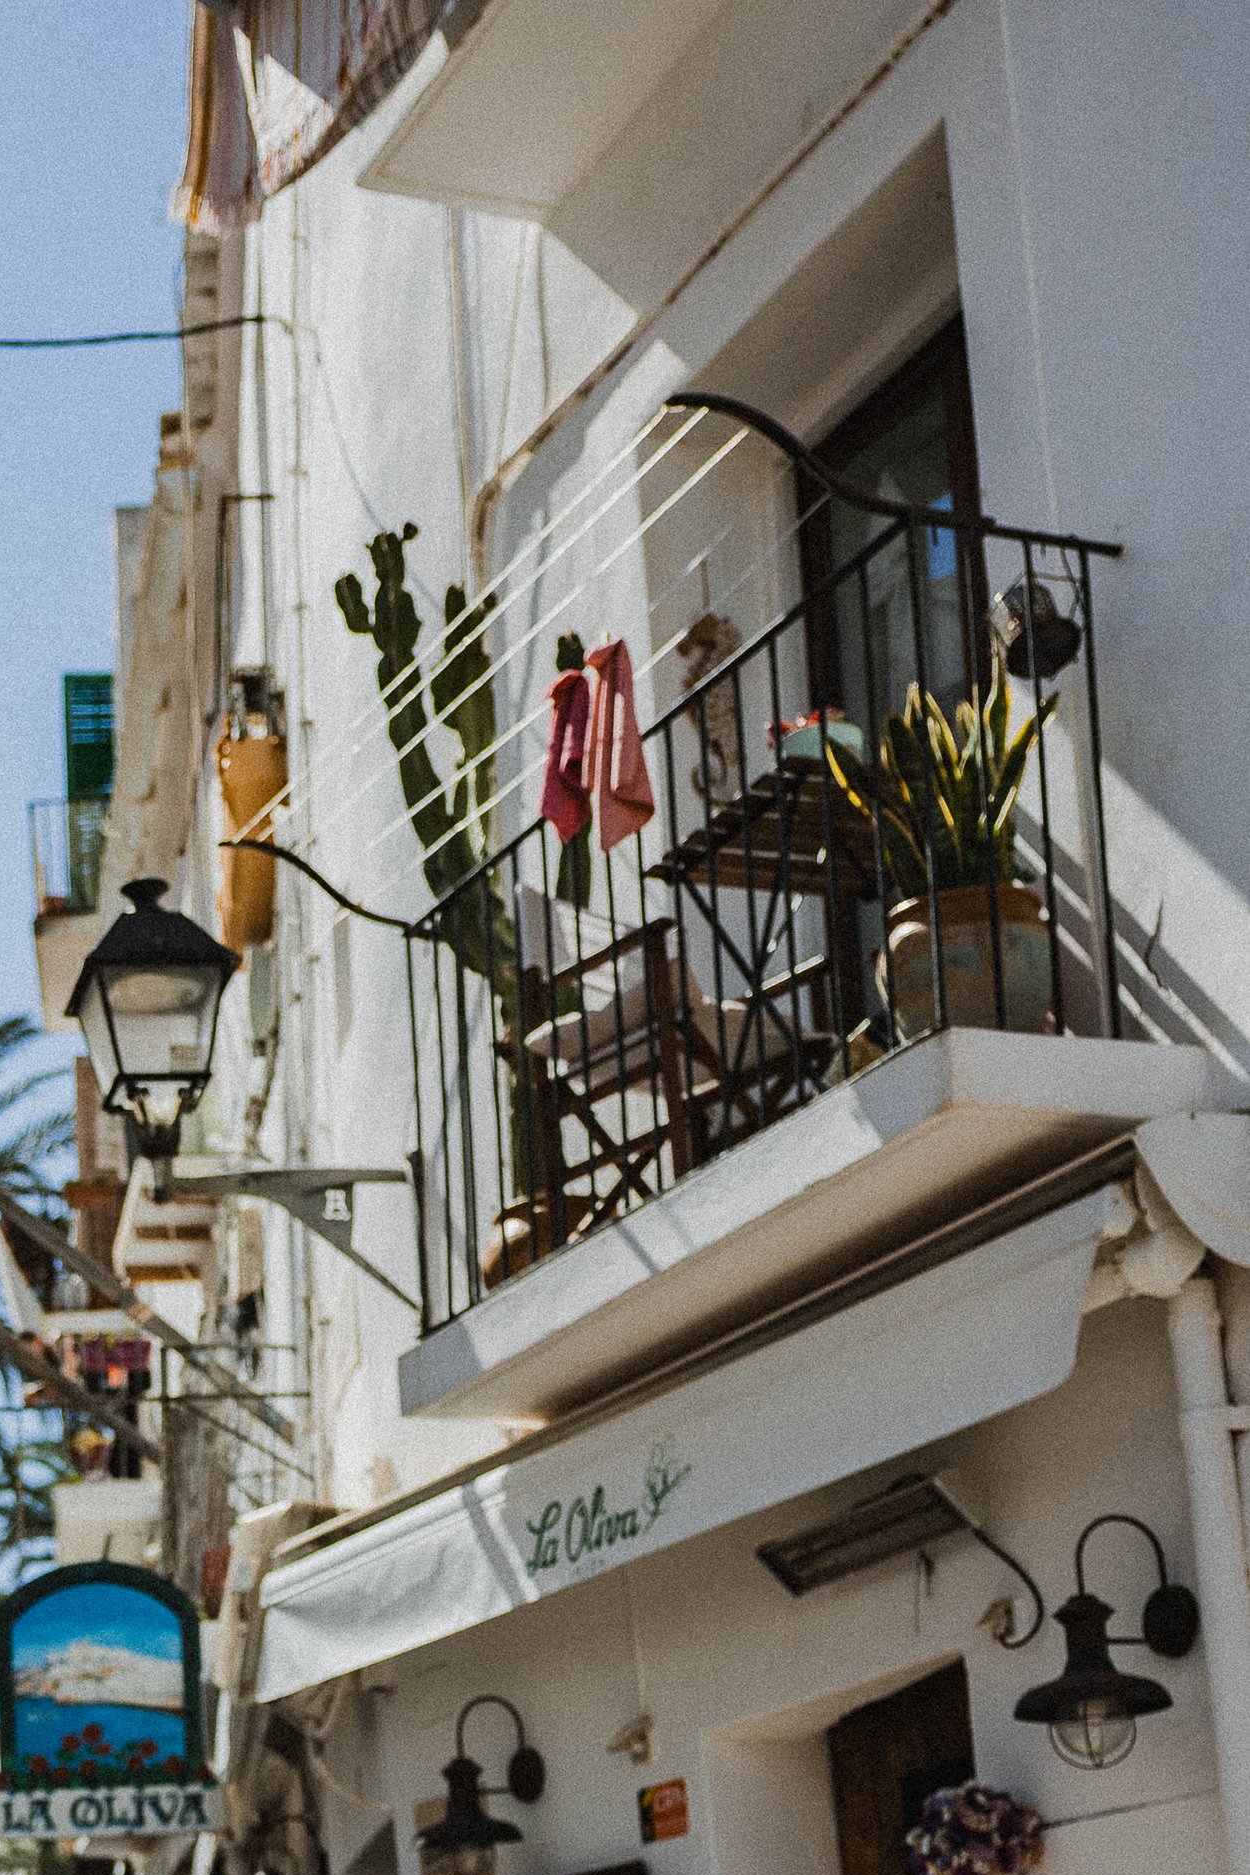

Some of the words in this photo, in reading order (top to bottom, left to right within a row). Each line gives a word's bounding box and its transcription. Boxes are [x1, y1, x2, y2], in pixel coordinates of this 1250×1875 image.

[525, 1500, 562, 1577] La
[565, 1485, 640, 1563] Oliva
[2, 1799, 54, 1831] LA
[69, 1795, 208, 1830] OLIVA
